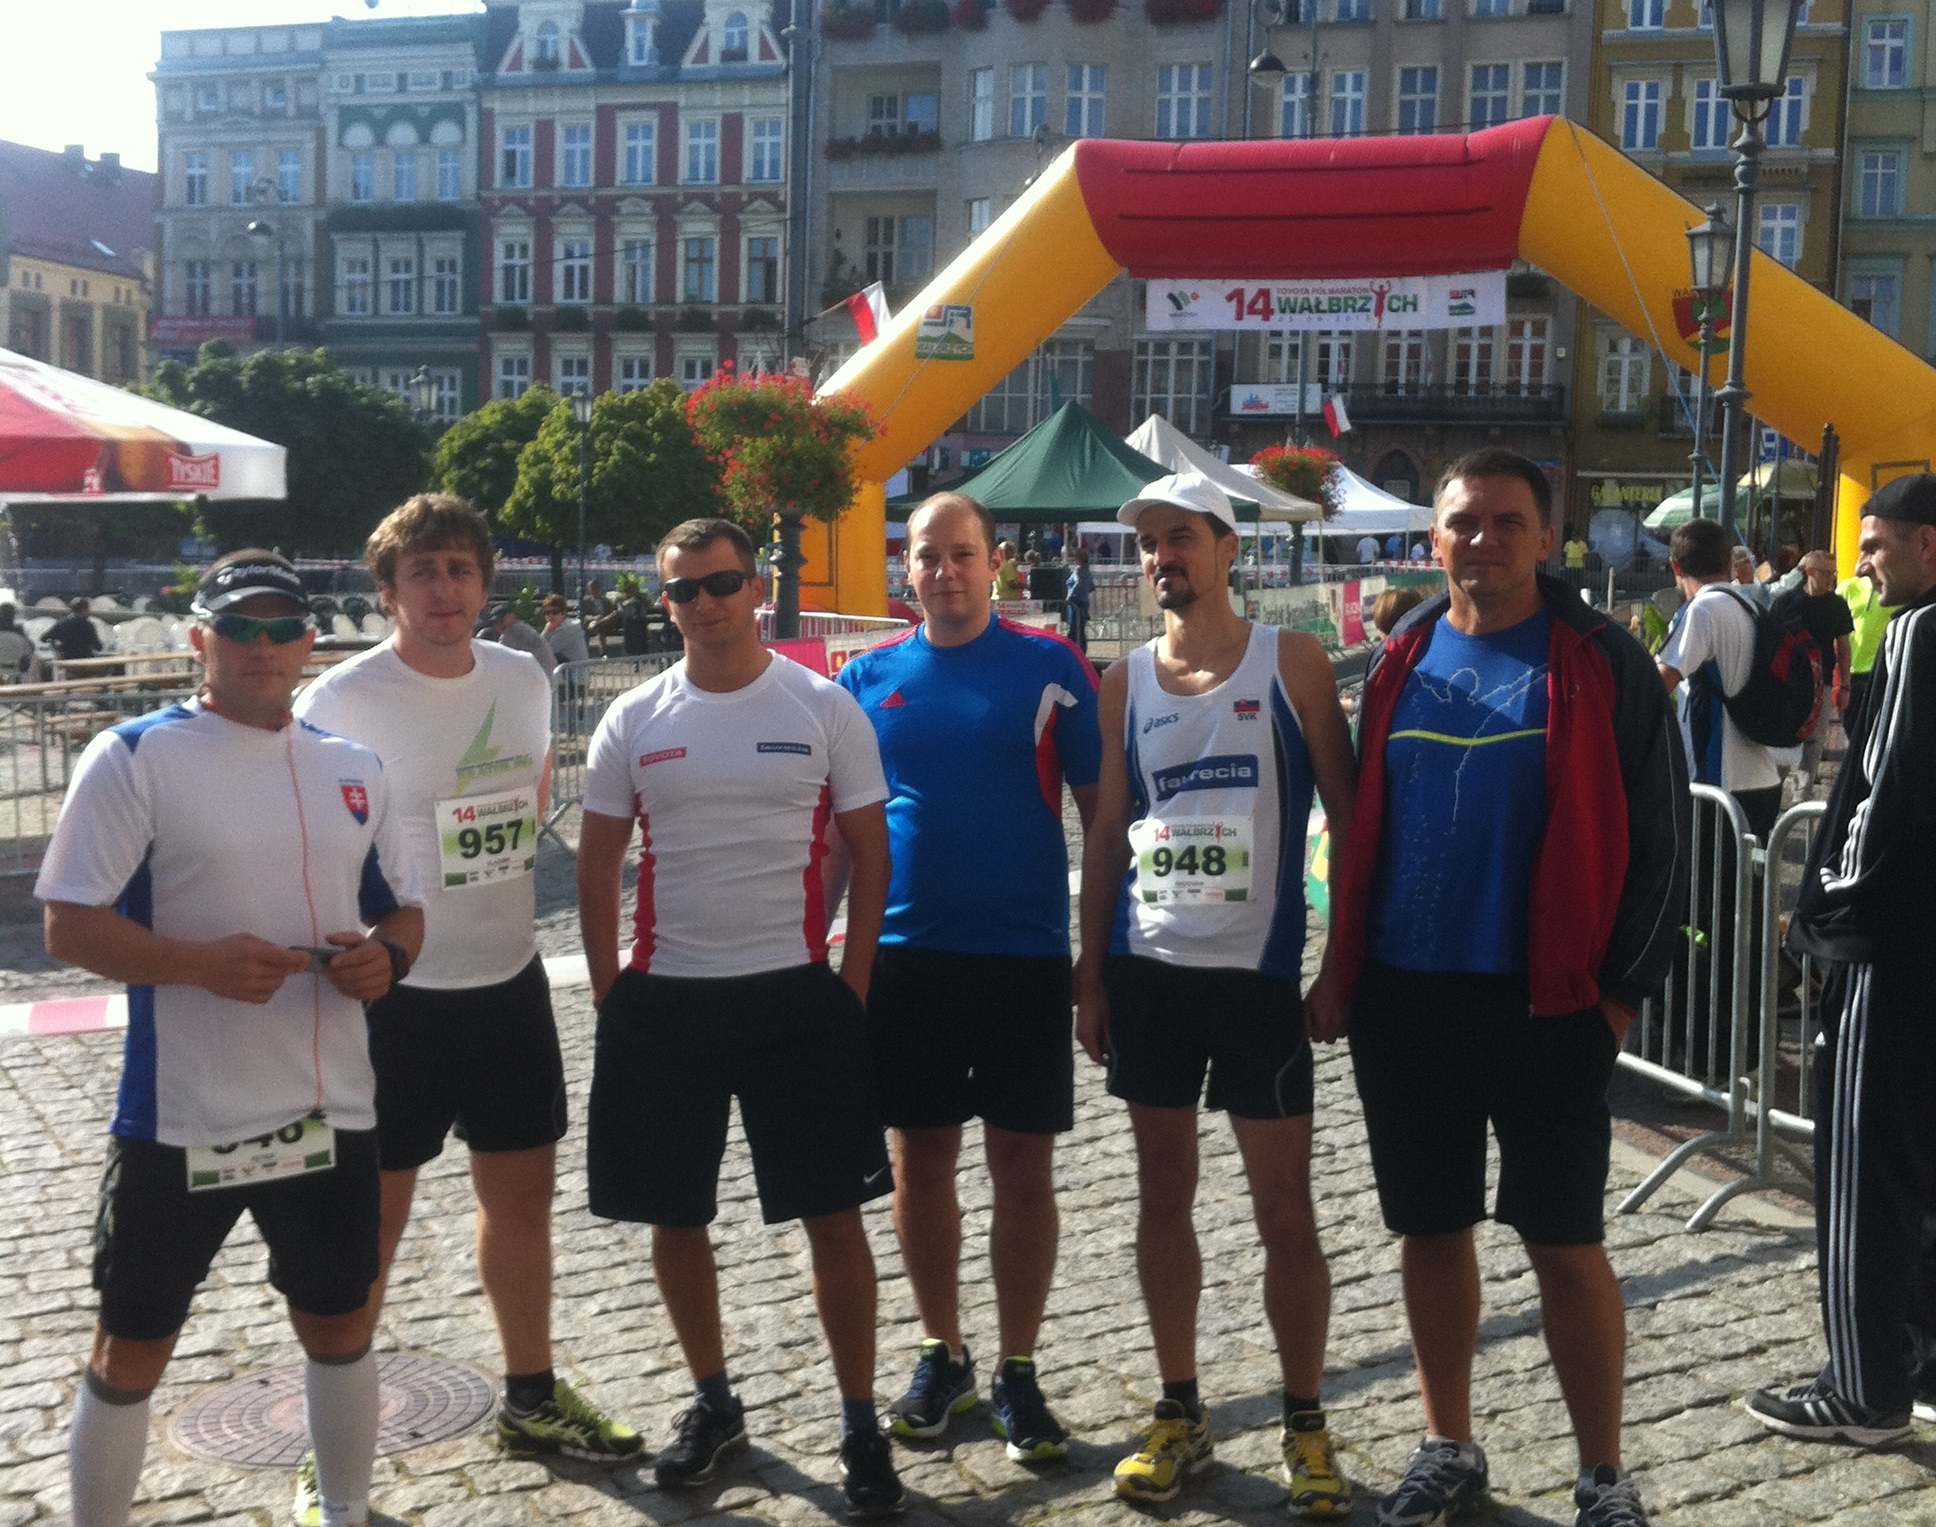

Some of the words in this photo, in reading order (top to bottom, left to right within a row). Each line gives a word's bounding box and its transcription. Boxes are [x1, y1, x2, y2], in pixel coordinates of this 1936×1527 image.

[1225, 287, 1275, 321] 14
[452, 806, 476, 823] 14
[457, 818, 523, 859] 957
[1153, 845, 1226, 877] 948
